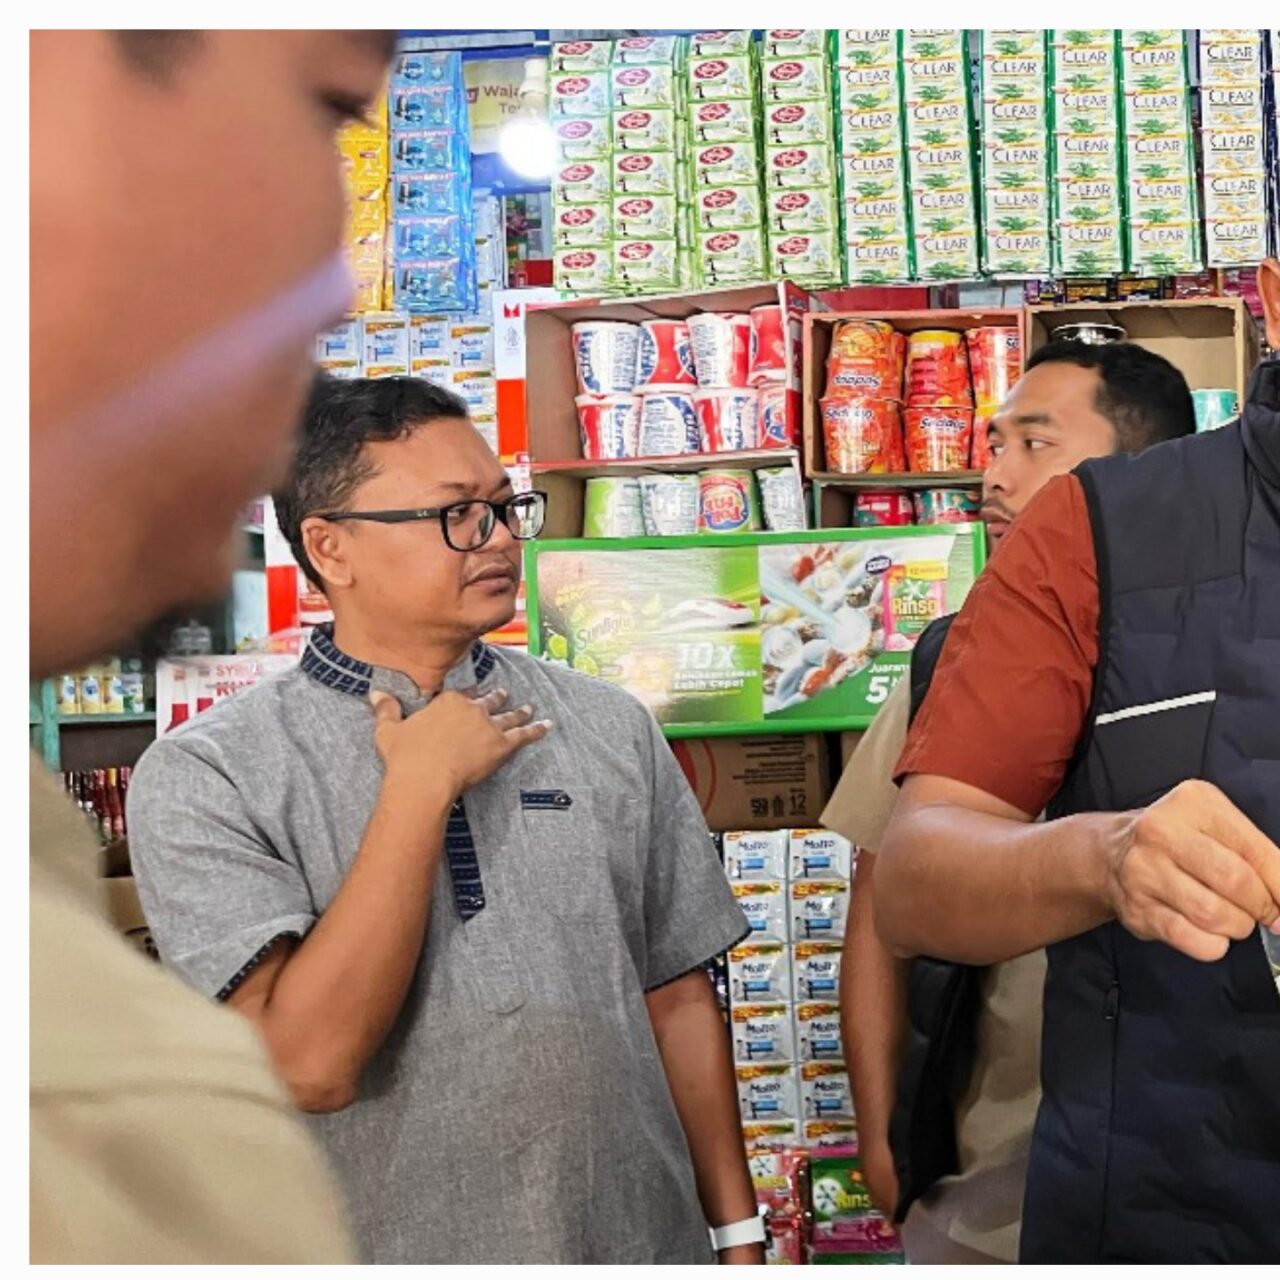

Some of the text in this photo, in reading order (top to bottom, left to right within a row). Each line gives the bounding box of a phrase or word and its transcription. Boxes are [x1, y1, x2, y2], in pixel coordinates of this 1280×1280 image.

[1063, 51, 1107, 64] CLEAR
[1131, 52, 1175, 64] CLEAR
[1207, 46, 1252, 59] CLEAR
[911, 63, 956, 76] CLEAR
[991, 62, 1037, 73] CLEAR
[846, 70, 890, 84] CLEAR
[1063, 96, 1107, 108] CLEAR
[1133, 96, 1177, 108] CLEAR
[1209, 90, 1253, 104] CLEAR
[914, 106, 959, 120] CLEAR
[992, 105, 1037, 118] CLEAR
[848, 114, 892, 127] CLEAR
[1065, 140, 1109, 152] CLEAR
[1135, 141, 1180, 153] CLEAR
[1210, 136, 1255, 148] CLEAR
[917, 151, 962, 164] CLEAR
[993, 151, 1038, 162] CLEAR
[850, 159, 894, 171] CLEAR
[1066, 185, 1111, 196] CLEAR
[1137, 186, 1183, 198] CLEAR
[1211, 179, 1256, 193] CLEAR
[920, 194, 964, 207] CLEAR
[994, 194, 1039, 206] CLEAR
[853, 203, 896, 216] CLEAR
[1068, 228, 1112, 240] CLEAR
[1213, 222, 1258, 235] CLEAR
[1139, 230, 1184, 242] CLEAR
[922, 239, 968, 251] CLEAR
[996, 237, 1040, 249] CLEAR
[855, 248, 898, 259] CLEAR
[892, 596, 937, 615] Rinso
[576, 615, 631, 650] Sunlight
[865, 676, 890, 704] 5
[836, 1191, 872, 1209] Rins
